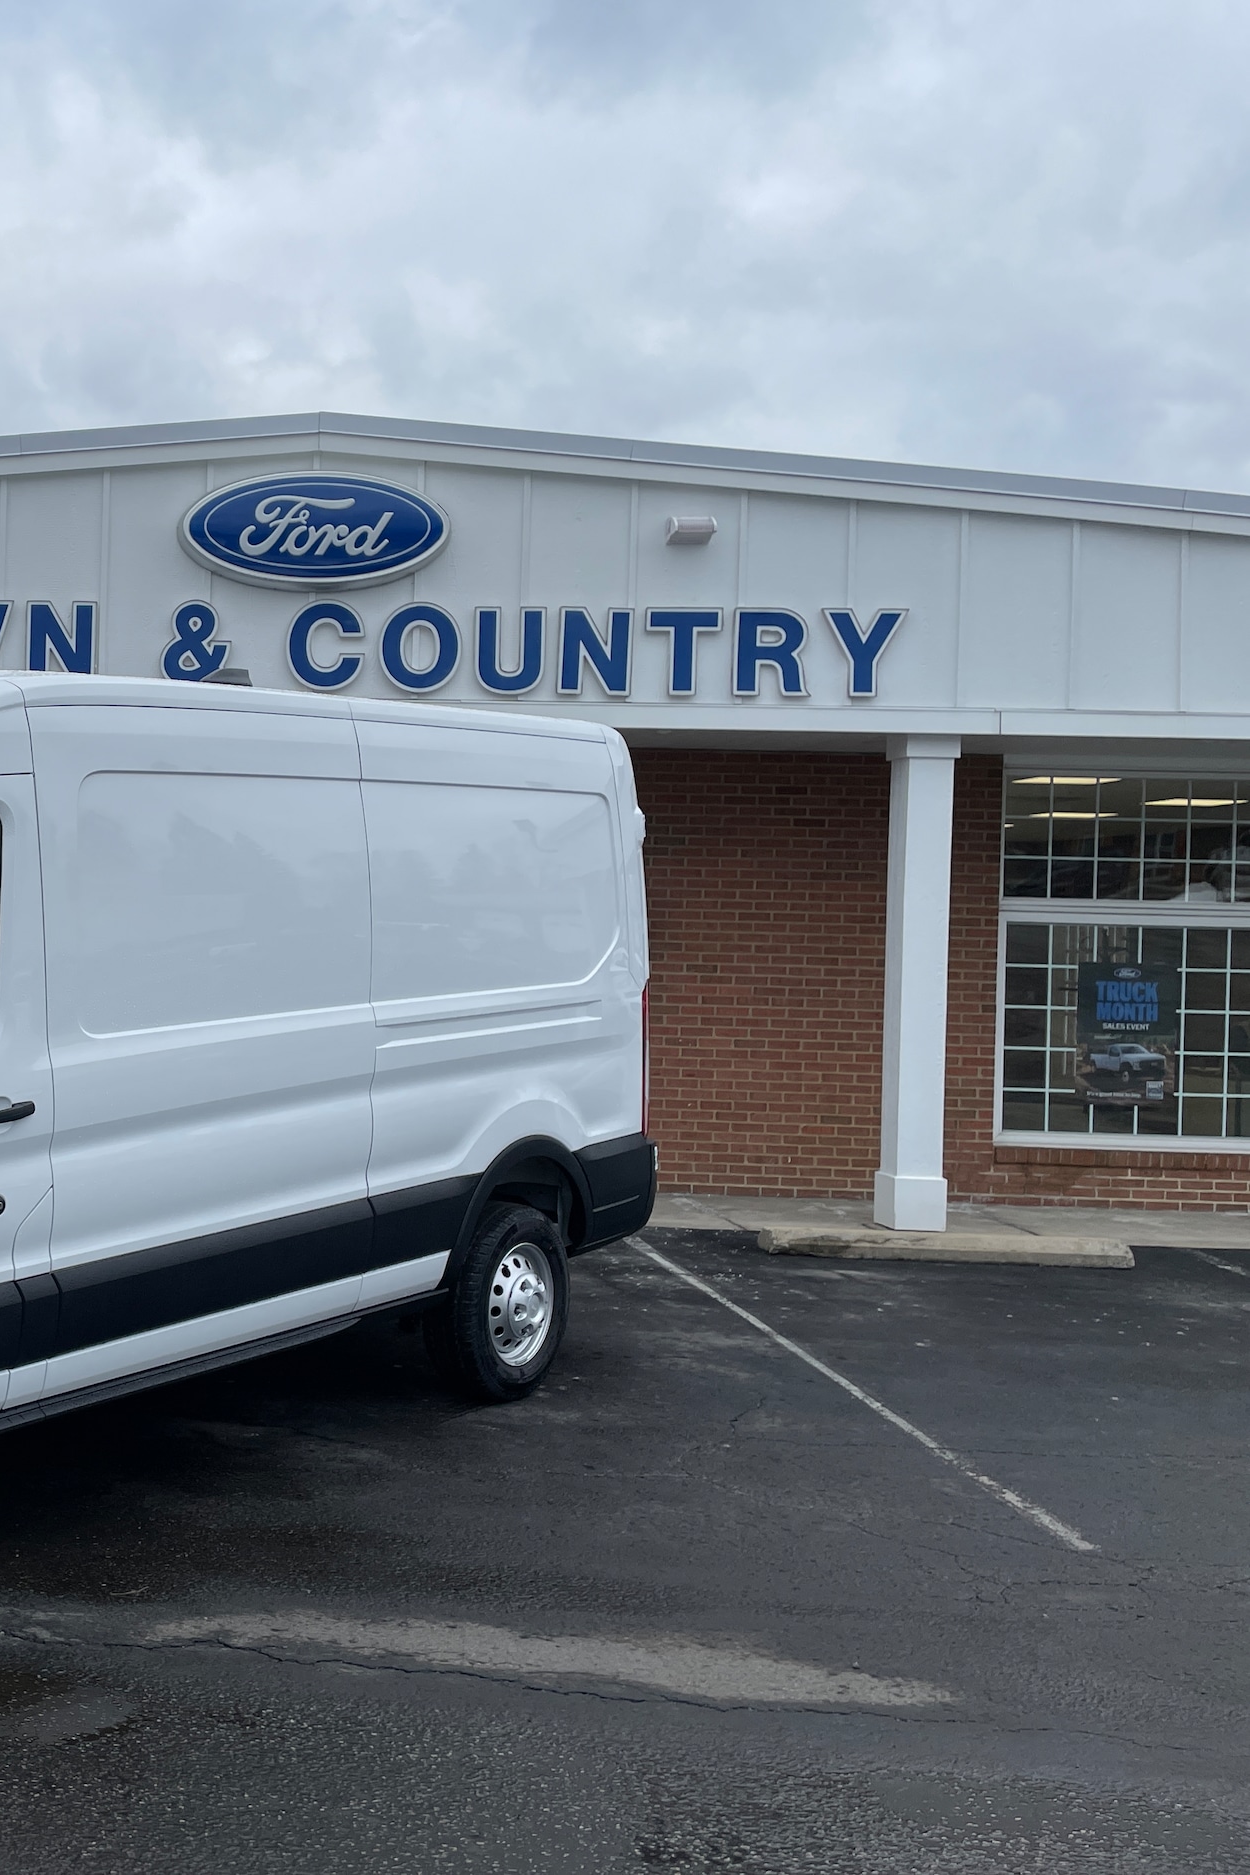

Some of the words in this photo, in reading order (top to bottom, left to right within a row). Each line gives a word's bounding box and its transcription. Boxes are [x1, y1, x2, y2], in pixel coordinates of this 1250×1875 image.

[239, 494, 395, 557] Ford
[160, 600, 231, 682] &
[287, 599, 909, 697] COUNTRY
[1096, 980, 1158, 1002] TRUCK
[1096, 1002, 1158, 1021] MONTH
[1102, 1022, 1126, 1030] SALES
[1126, 1023, 1150, 1031] EVENT
